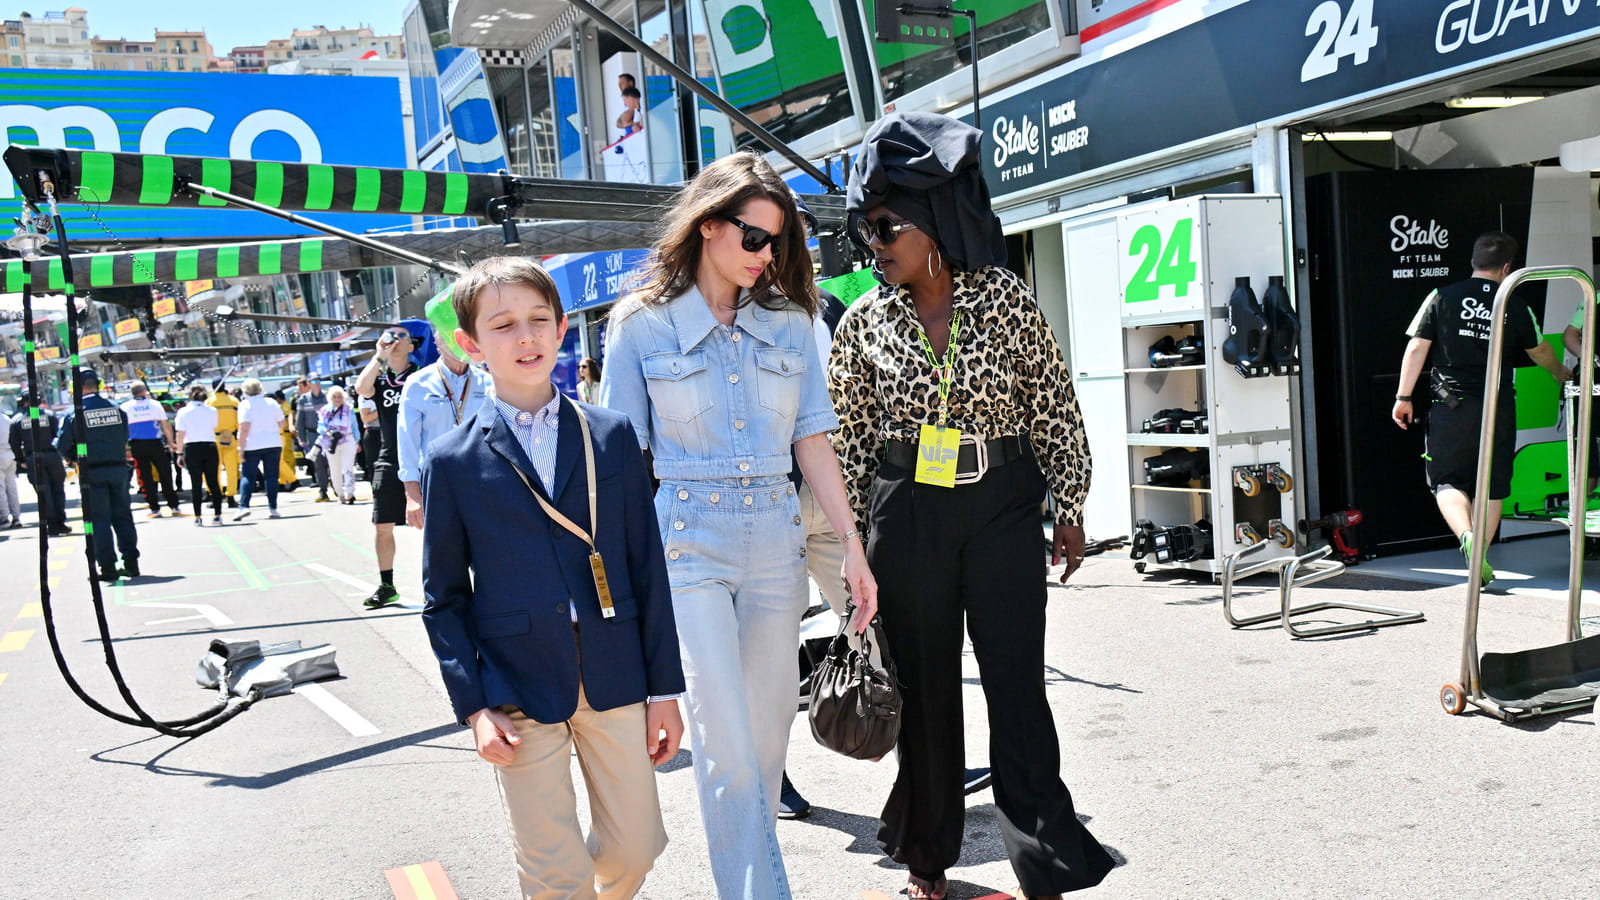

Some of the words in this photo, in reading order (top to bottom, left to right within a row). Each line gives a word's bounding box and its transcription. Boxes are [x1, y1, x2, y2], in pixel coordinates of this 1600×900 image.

[1301, 0, 1379, 82] 24
[1048, 100, 1076, 128] KICK
[993, 115, 1039, 168] Stake
[1050, 126, 1089, 156] SAUBER
[1013, 162, 1034, 178] TEAM
[1390, 215, 1449, 252] Stake
[1125, 218, 1197, 304] 24
[1392, 269, 1414, 279] KICK
[1420, 267, 1449, 278] SAUBER
[1415, 254, 1441, 263] TEAM
[583, 262, 598, 301] 22
[1460, 297, 1493, 320] Sta
[920, 444, 957, 465] VIP
